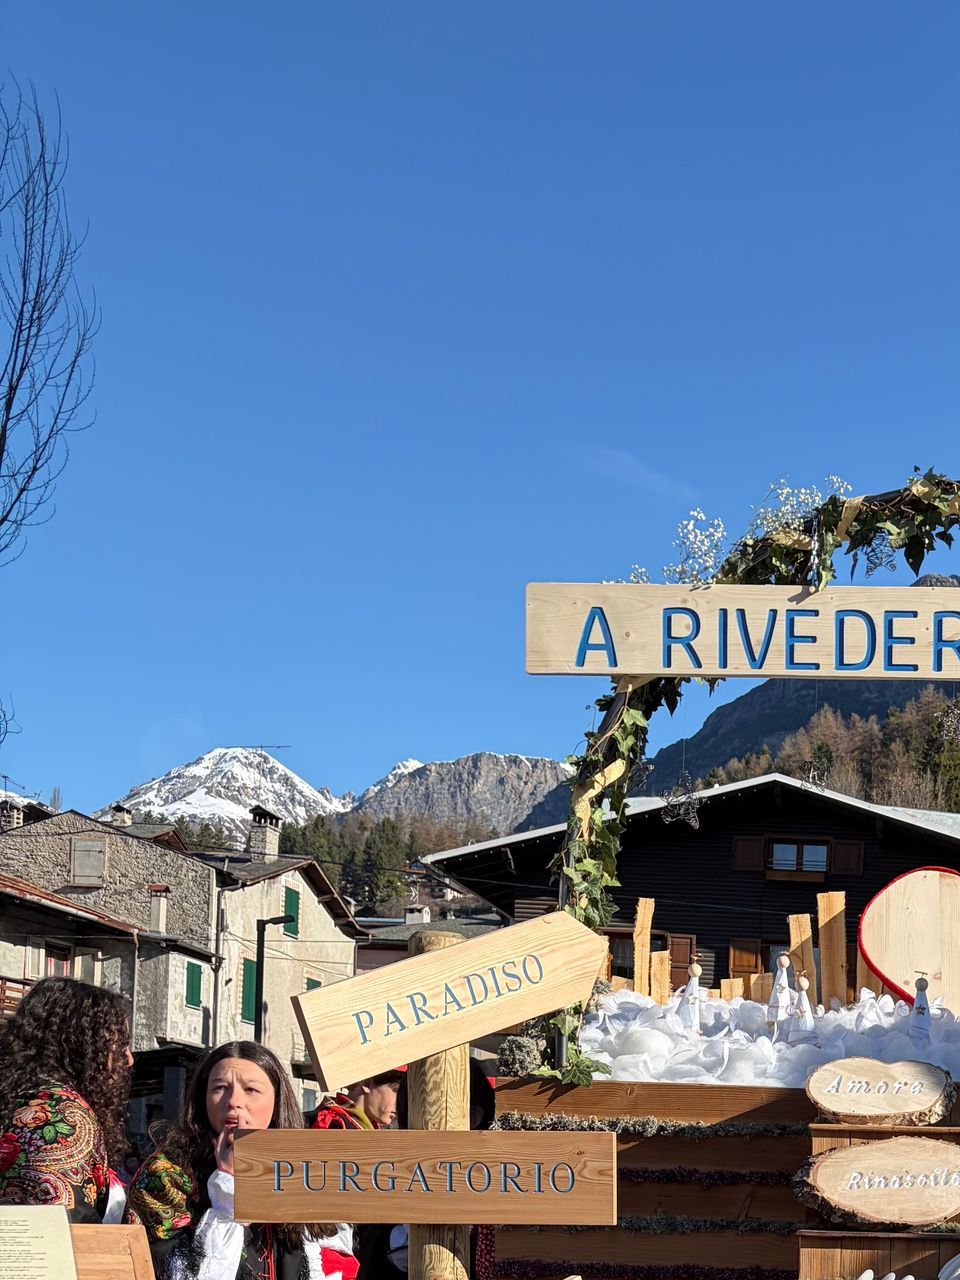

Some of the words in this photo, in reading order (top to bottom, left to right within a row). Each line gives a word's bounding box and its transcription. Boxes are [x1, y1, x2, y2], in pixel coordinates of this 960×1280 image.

[575, 606, 619, 668] A
[352, 954, 545, 1045] PARADISO
[824, 1074, 925, 1096] Amore
[272, 1160, 576, 1194] PURGATORIO
